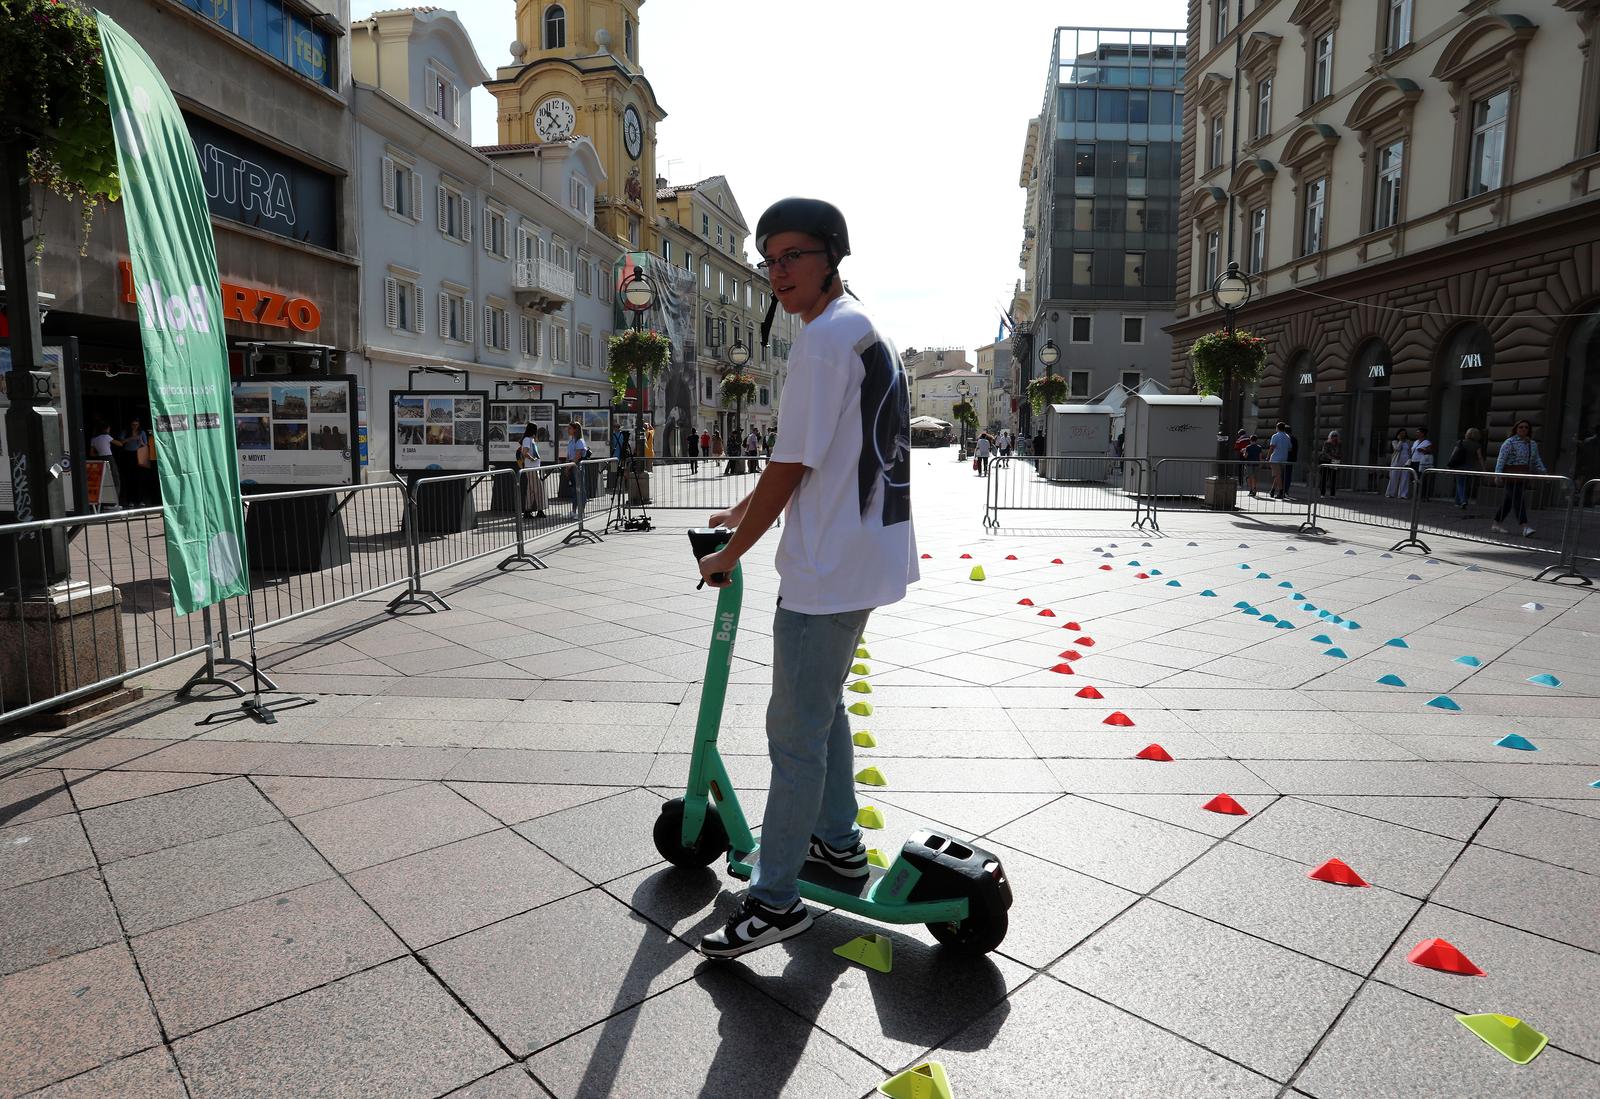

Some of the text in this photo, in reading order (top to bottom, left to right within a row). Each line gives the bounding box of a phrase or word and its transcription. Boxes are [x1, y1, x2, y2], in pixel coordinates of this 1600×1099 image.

[293, 35, 326, 72] TEDi
[1460, 353, 1482, 369] ZARA
[1299, 373, 1313, 384] ZARA
[1368, 365, 1385, 378] ZARA
[248, 454, 266, 462] MIDYAT
[716, 612, 735, 641] Bolt
